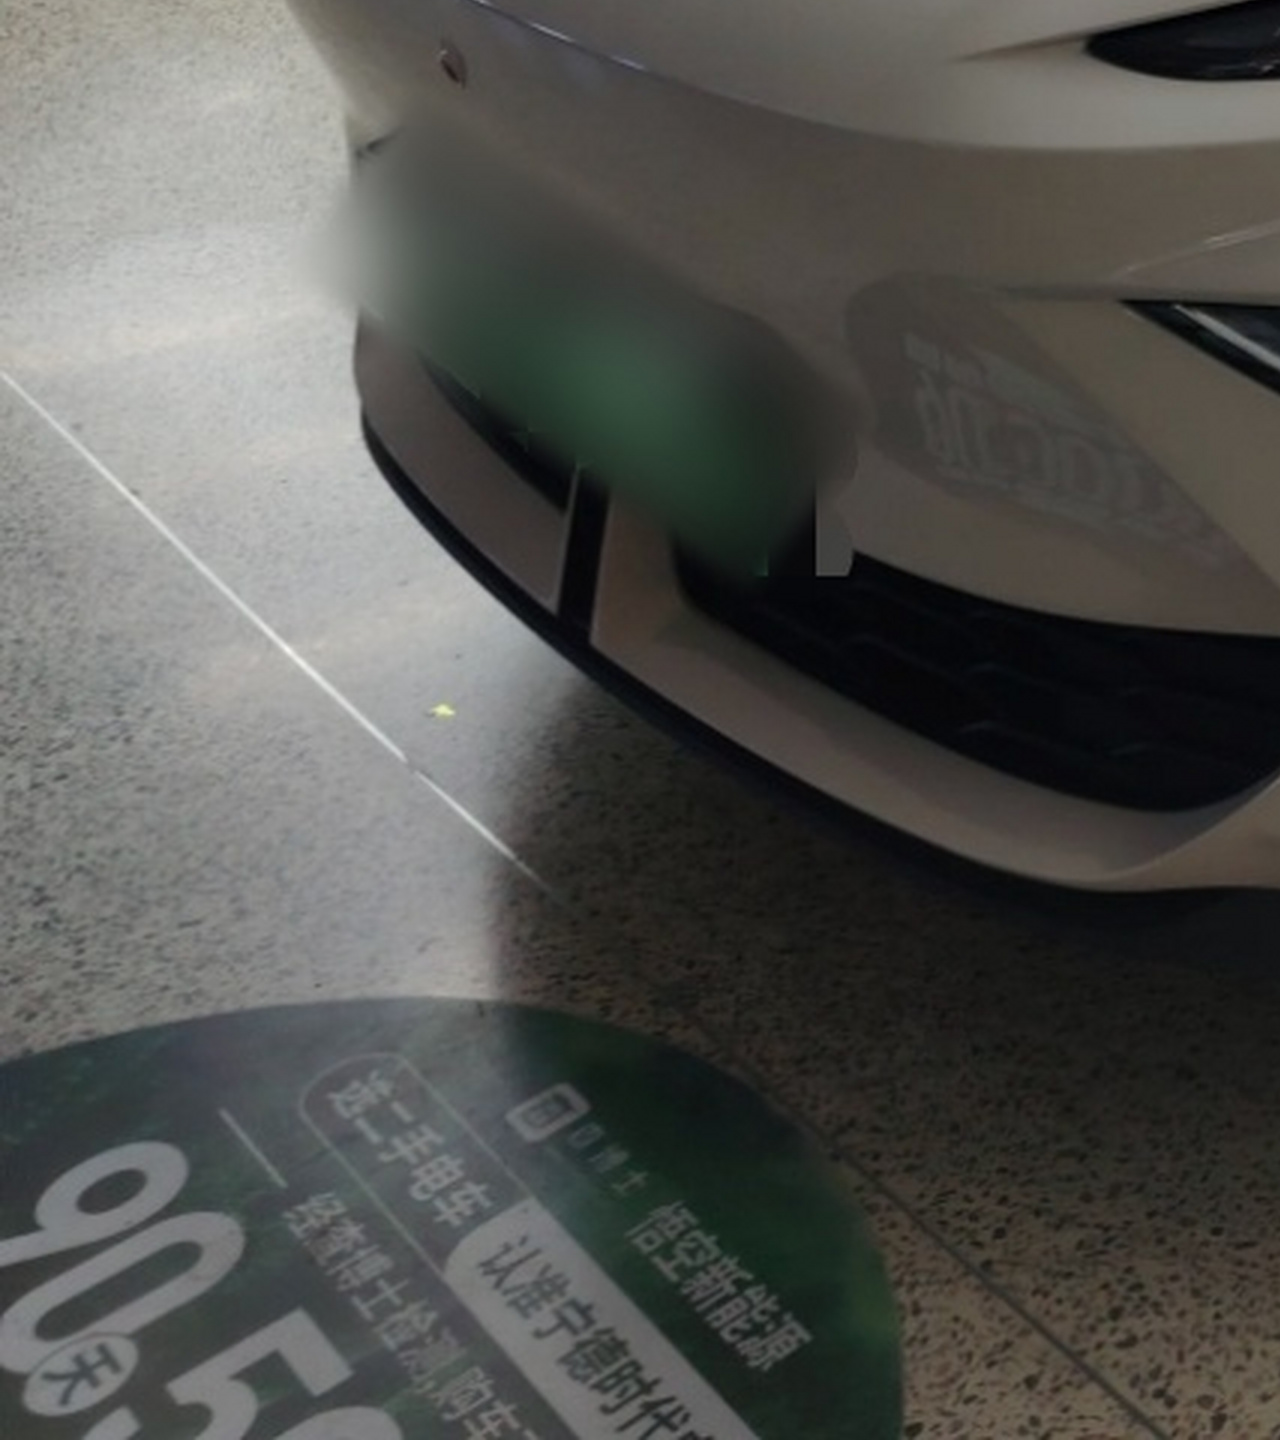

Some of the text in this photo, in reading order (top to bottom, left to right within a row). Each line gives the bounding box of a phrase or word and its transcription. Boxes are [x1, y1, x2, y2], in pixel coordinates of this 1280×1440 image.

[326, 1070, 493, 1227] 选二手电车
[477, 1234, 718, 1440] 认准宁德时代
[624, 1200, 814, 1371] 悟空新能源
[40, 1342, 123, 1407] 天
